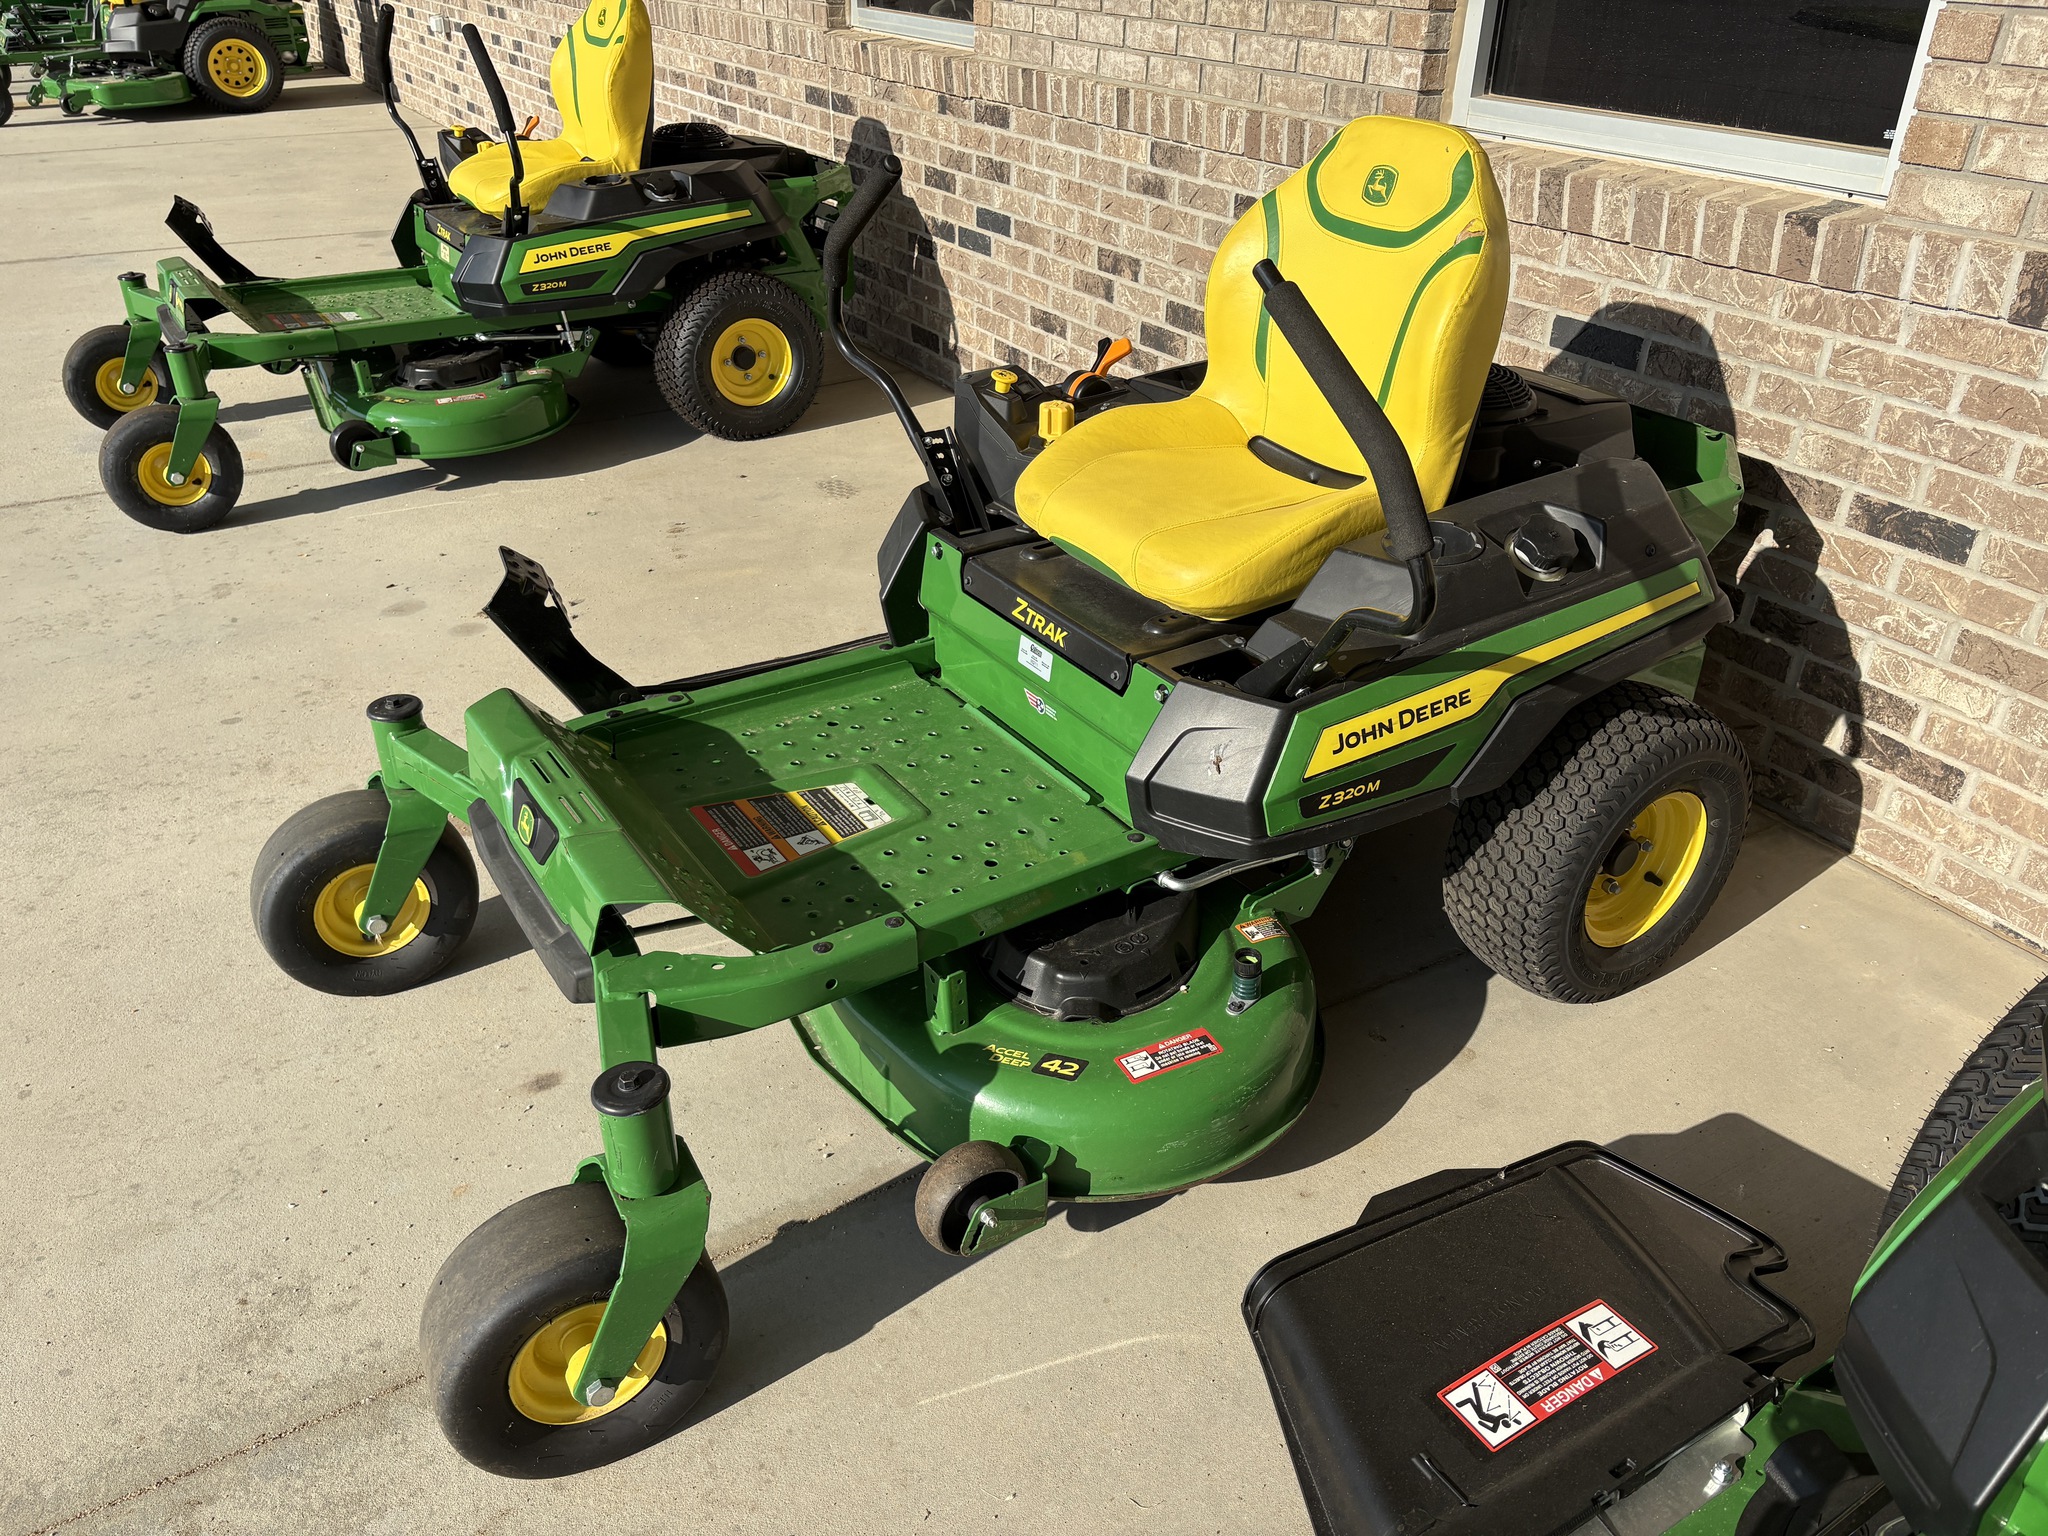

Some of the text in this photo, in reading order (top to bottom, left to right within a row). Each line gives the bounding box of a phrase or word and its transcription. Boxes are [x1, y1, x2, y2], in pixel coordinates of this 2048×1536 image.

[533, 242, 612, 264] JOHN DEERE
[532, 280, 567, 292] Z320M
[1012, 596, 1069, 648] ZTRAK
[1332, 688, 1472, 756] JOHN DEERE
[1318, 780, 1382, 810] Z320M
[752, 816, 774, 836] WARNING
[711, 828, 732, 849] DANGER
[1165, 1033, 1192, 1047] DANGER
[983, 1043, 1030, 1060] ACCEL
[988, 1053, 1032, 1068] DEEP
[1040, 1059, 1080, 1077] 42
[1533, 1341, 1553, 1354] OPERATE
[1518, 1352, 1535, 1363] MOWER
[1565, 1354, 1581, 1364] MOWER
[1499, 1361, 1520, 1374] WITHOUT
[1521, 1350, 1576, 1385] THROWN OBJECTS
[1554, 1362, 1567, 1371] WHEN
[1557, 1366, 1572, 1376] HANDS
[1536, 1363, 1588, 1396] ROTATING BLADE
[1538, 1369, 1557, 1381] MACHINE
[1541, 1377, 1553, 1386] FEET
[1516, 1382, 1535, 1395] RUNNING
[1527, 1384, 1543, 1394] UNDER
[1538, 1375, 1595, 1413] DANGER
